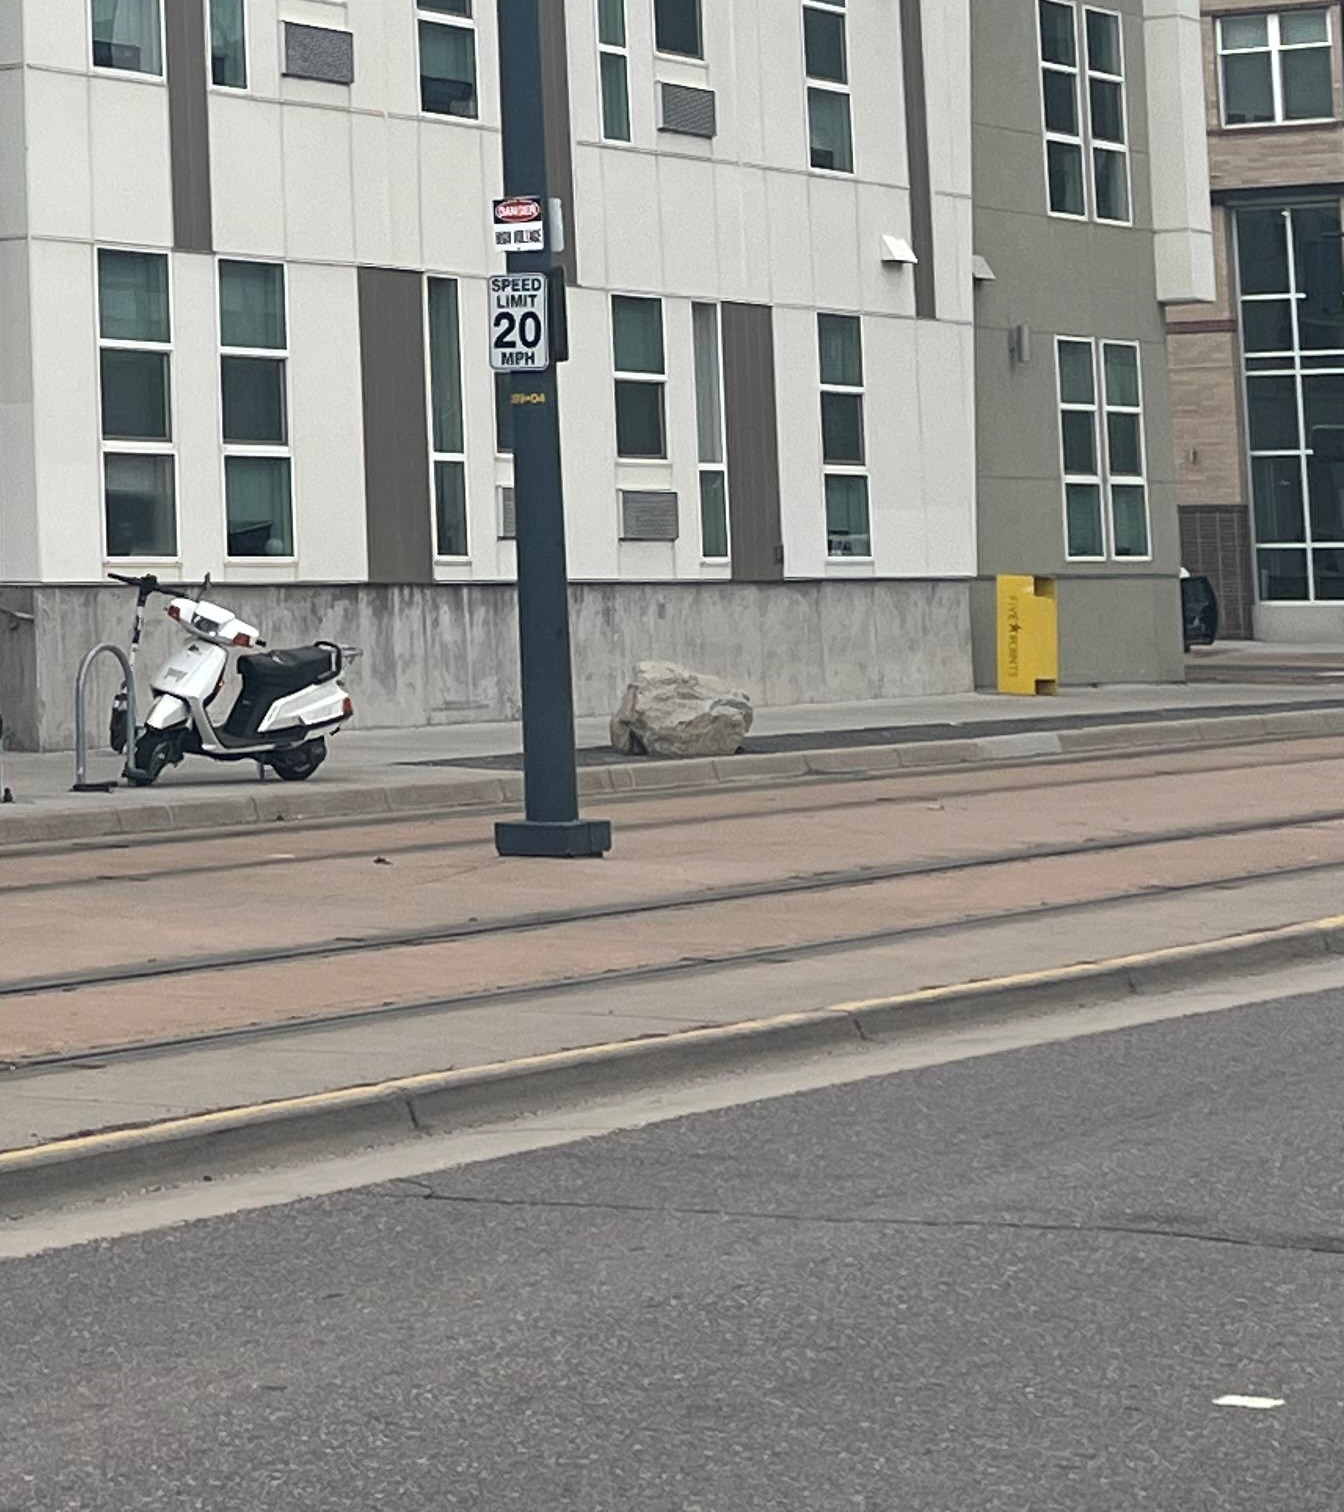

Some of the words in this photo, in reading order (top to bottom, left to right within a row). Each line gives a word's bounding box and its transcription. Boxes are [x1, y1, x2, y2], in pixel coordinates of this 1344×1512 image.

[491, 277, 542, 292] SPEED
[496, 294, 538, 309] LIMIT
[493, 311, 542, 349] 20
[501, 351, 535, 366] MPH
